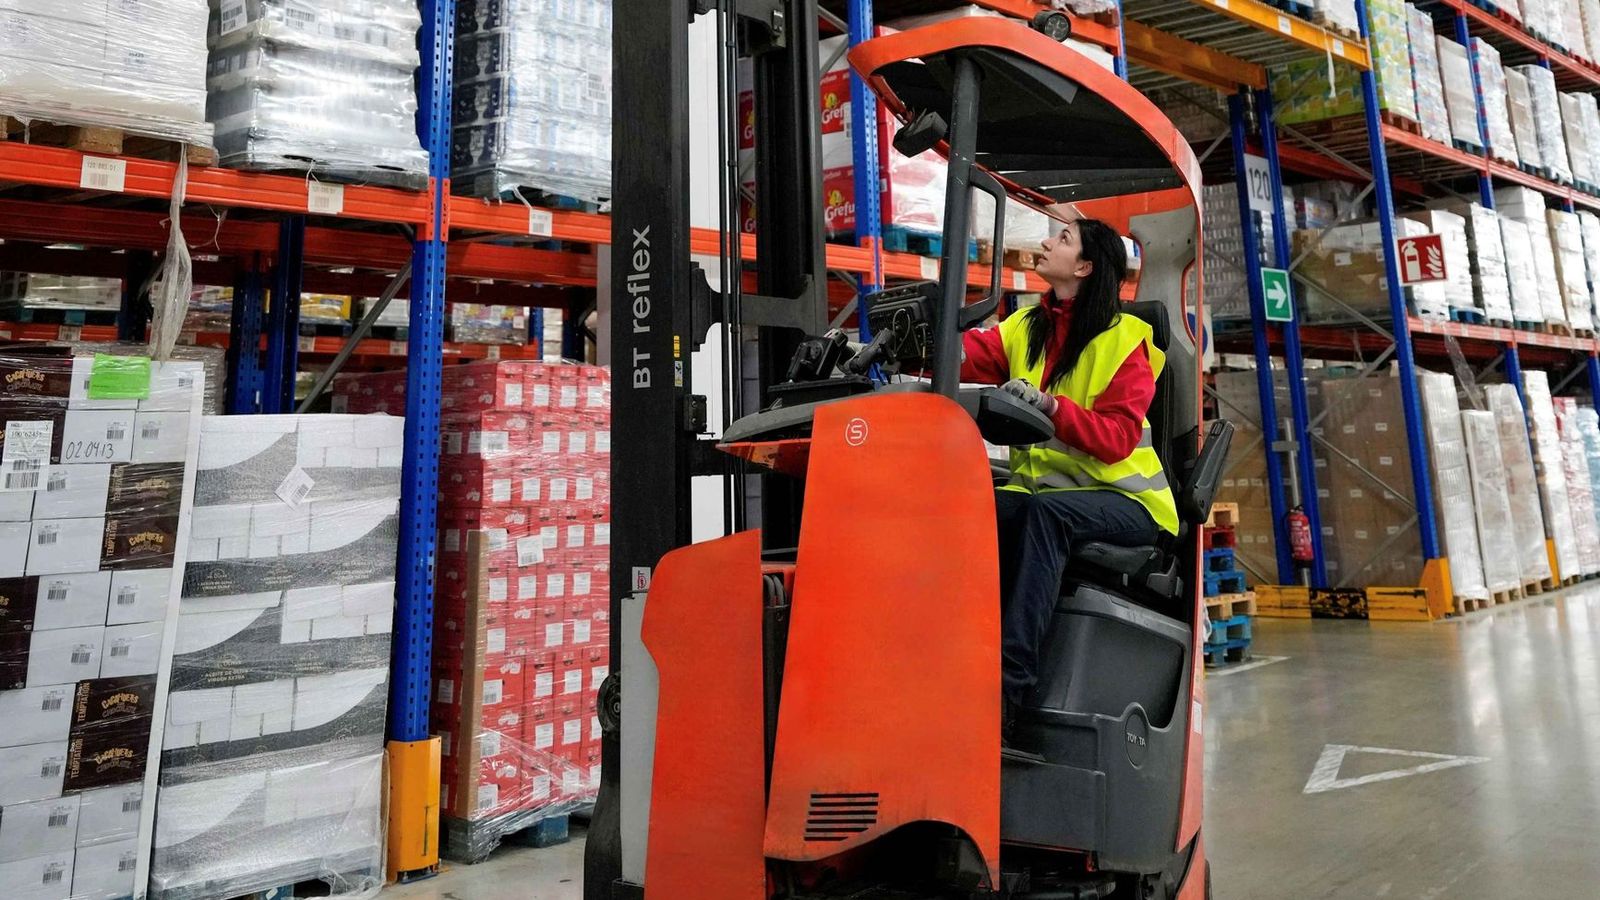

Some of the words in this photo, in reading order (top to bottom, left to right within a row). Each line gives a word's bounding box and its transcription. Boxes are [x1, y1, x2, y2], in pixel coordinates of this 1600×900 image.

[1249, 168, 1271, 201] 120
[627, 224, 651, 334] reflex
[633, 347, 651, 389] BT
[77, 682, 91, 723] TEMPTATION
[70, 738, 84, 779] TEMPTATION
[1126, 732, 1146, 747] TOYTA
